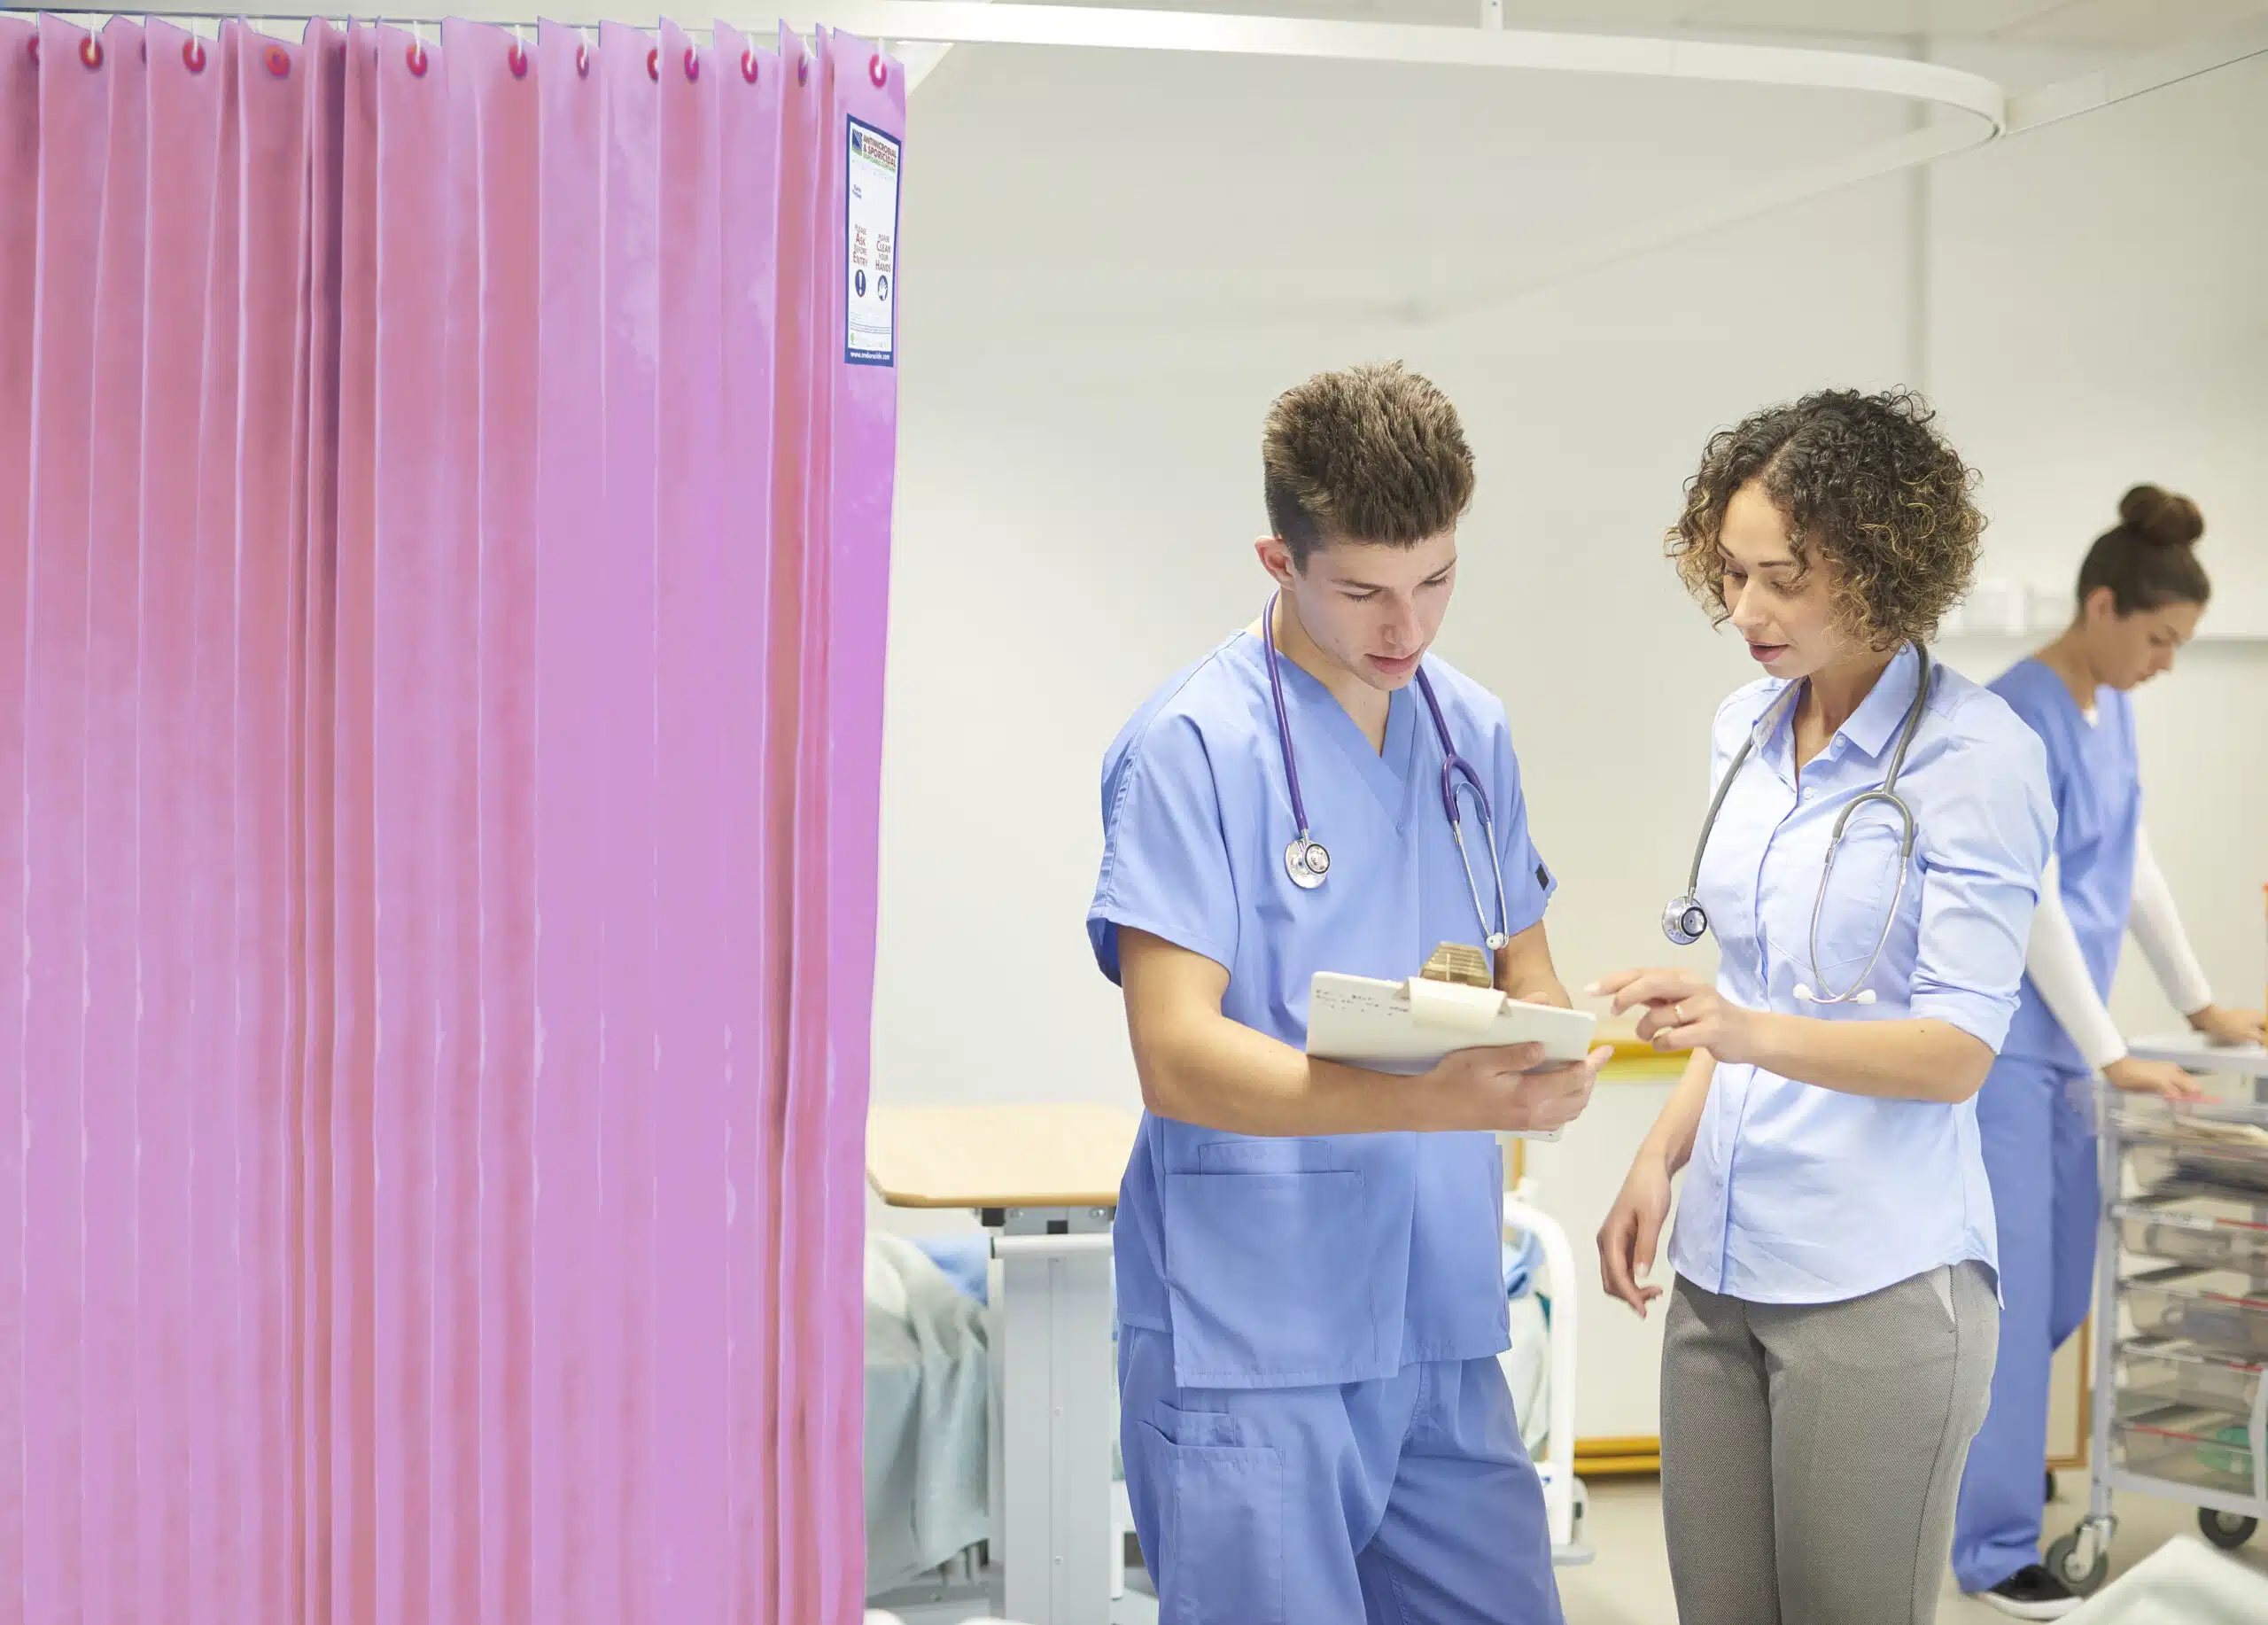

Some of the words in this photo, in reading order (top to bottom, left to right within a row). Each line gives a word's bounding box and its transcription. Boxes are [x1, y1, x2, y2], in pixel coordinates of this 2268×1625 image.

[876, 240, 891, 253] CLEAN
[852, 251, 868, 267] ENTRY
[875, 260, 891, 272] HANDS
